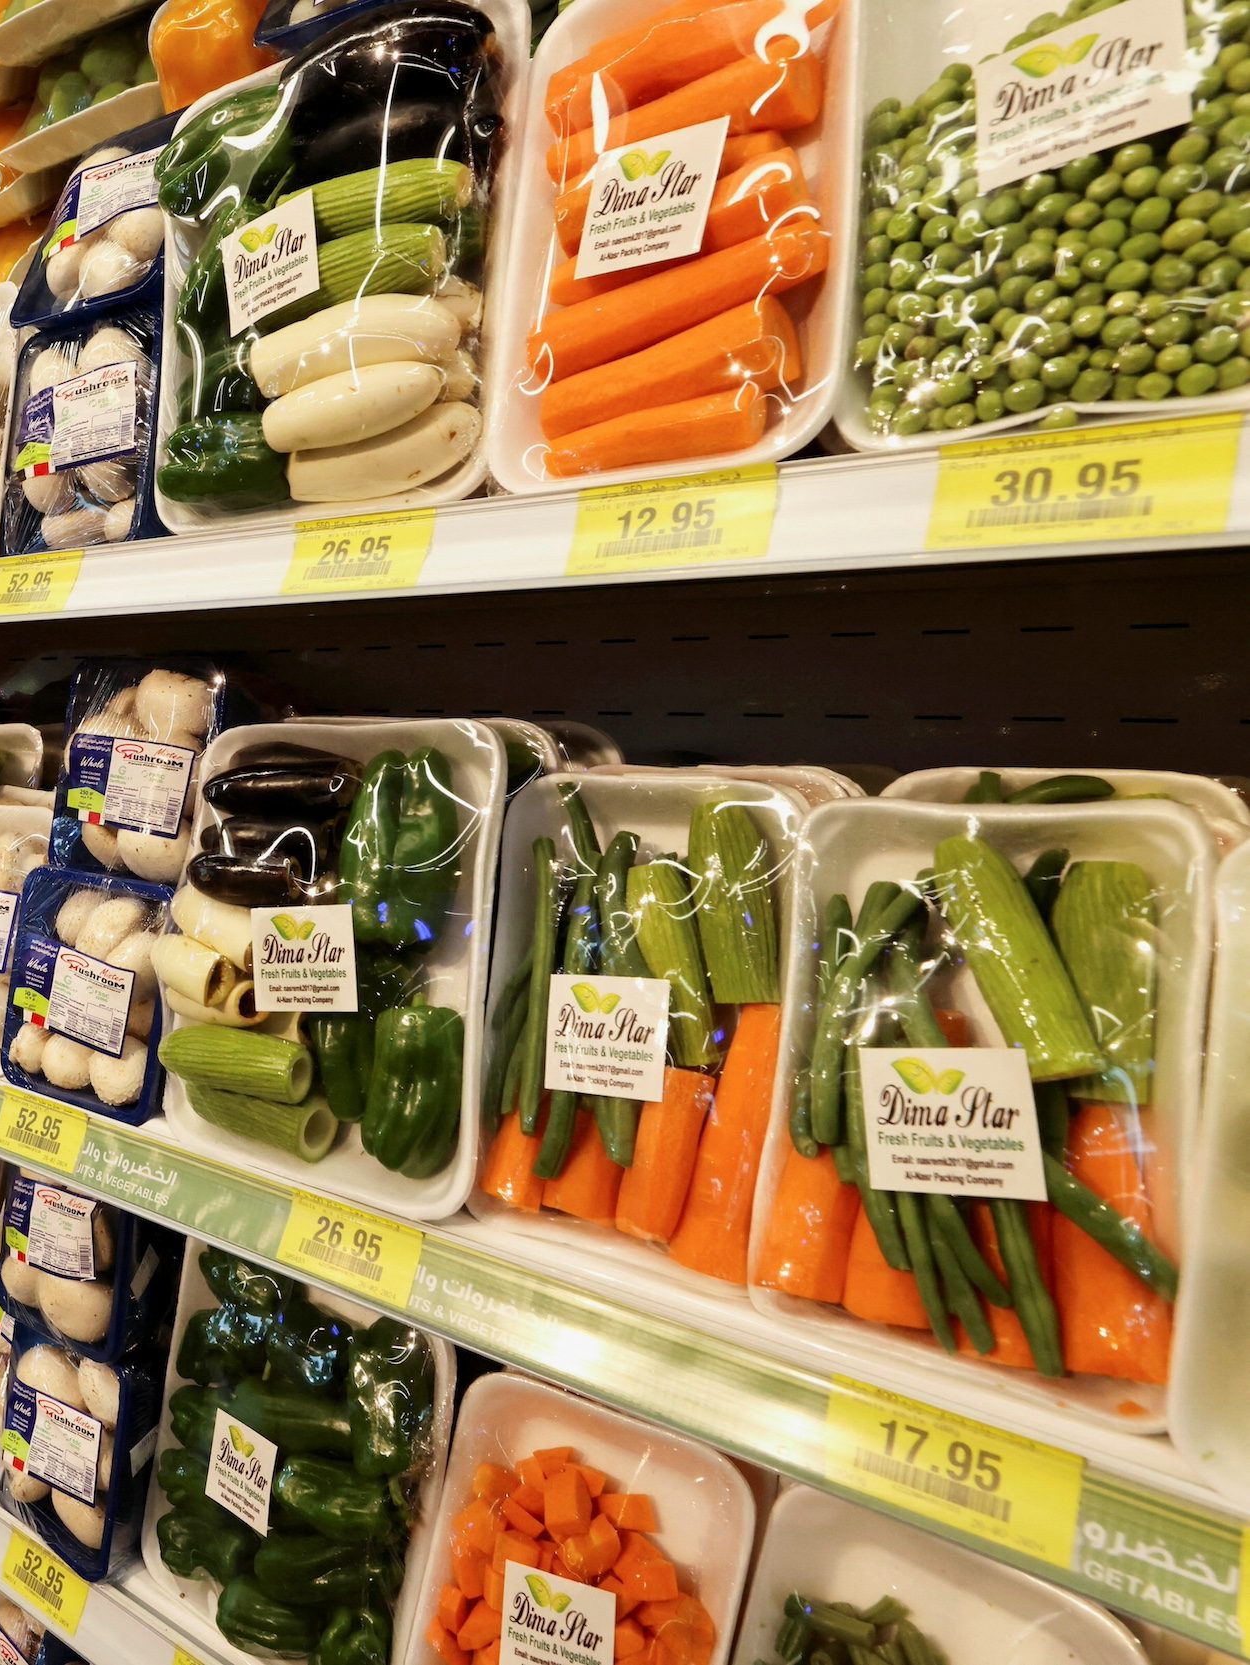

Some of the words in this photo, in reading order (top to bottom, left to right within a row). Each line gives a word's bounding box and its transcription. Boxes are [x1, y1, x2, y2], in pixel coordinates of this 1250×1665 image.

[989, 75, 1076, 126] Dima
[1084, 37, 1164, 87] Star
[988, 122, 1027, 145] Fresh
[1029, 108, 1068, 127] Fruits
[593, 178, 650, 218] Dima
[651, 160, 702, 203] Star
[589, 221, 612, 236] Fresh
[613, 216, 637, 230] Fruits
[640, 211, 646, 224] &
[649, 201, 696, 222] Vegetables
[233, 251, 269, 288] Dima
[271, 227, 307, 263] Star
[620, 247, 642, 257] Packing
[643, 241, 670, 252] Company
[234, 285, 249, 302] Fresh
[249, 275, 266, 291] Fruits
[267, 270, 273, 280] &
[273, 253, 309, 277] Vegetables
[260, 296, 277, 310] Packing
[276, 286, 297, 300] Company
[991, 459, 1141, 507] 30.95
[617, 499, 716, 540] 12.95
[317, 535, 391, 566] 26.95
[7, 571, 54, 594] 52.95
[80, 756, 105, 769] Whole
[26, 957, 49, 973] Whole
[260, 934, 305, 965] Dima
[308, 932, 345, 964] Star
[260, 968, 280, 979] Fresh
[281, 968, 301, 979] Fruits
[302, 968, 308, 979] &
[309, 968, 347, 981] Vegetables
[269, 984, 282, 992] Email:
[277, 996, 292, 1004] Al-Nasr
[293, 996, 311, 1005] Packing
[312, 996, 334, 1005] Company
[555, 1003, 606, 1040] Dima
[609, 1007, 655, 1045] Star
[553, 1041, 573, 1054] Fresh
[575, 1043, 599, 1057] Fruits
[600, 1046, 607, 1058] &
[608, 1046, 654, 1062] Vegetables
[609, 1078, 635, 1090] Company
[16, 1107, 63, 1140] 52.95
[877, 1084, 950, 1127] Dima
[955, 1086, 1021, 1130] Star
[877, 1131, 909, 1147] Fresh
[911, 1132, 944, 1148] Fruits
[948, 1133, 956, 1149] &
[958, 1133, 1025, 1153] Vegetables
[891, 1154, 913, 1165] Email:
[102, 1148, 178, 1187] الخضروات
[905, 1171, 932, 1182] Al-Nasr
[933, 1172, 965, 1186] Packing
[966, 1174, 1004, 1188] Company
[95, 1170, 103, 1182] &
[105, 1174, 170, 1207] VEGETABLES
[312, 1215, 383, 1263] 26.95
[434, 1304, 445, 1320] &
[13, 1400, 32, 1418] Whole
[216, 1437, 246, 1476] Dima
[245, 1456, 268, 1491] Star
[878, 1418, 1004, 1493] 17.95
[215, 1462, 227, 1477] Fresh
[226, 1469, 239, 1487] Fruits
[239, 1479, 244, 1489] &
[244, 1482, 266, 1506] Vegetables
[22, 1548, 66, 1595] 52.95
[509, 1591, 557, 1637] Dima
[559, 1610, 603, 1651] Star
[507, 1626, 528, 1644] Fresh
[529, 1634, 551, 1653] Fruits
[552, 1643, 558, 1655] &
[559, 1645, 602, 1665] Vegetables
